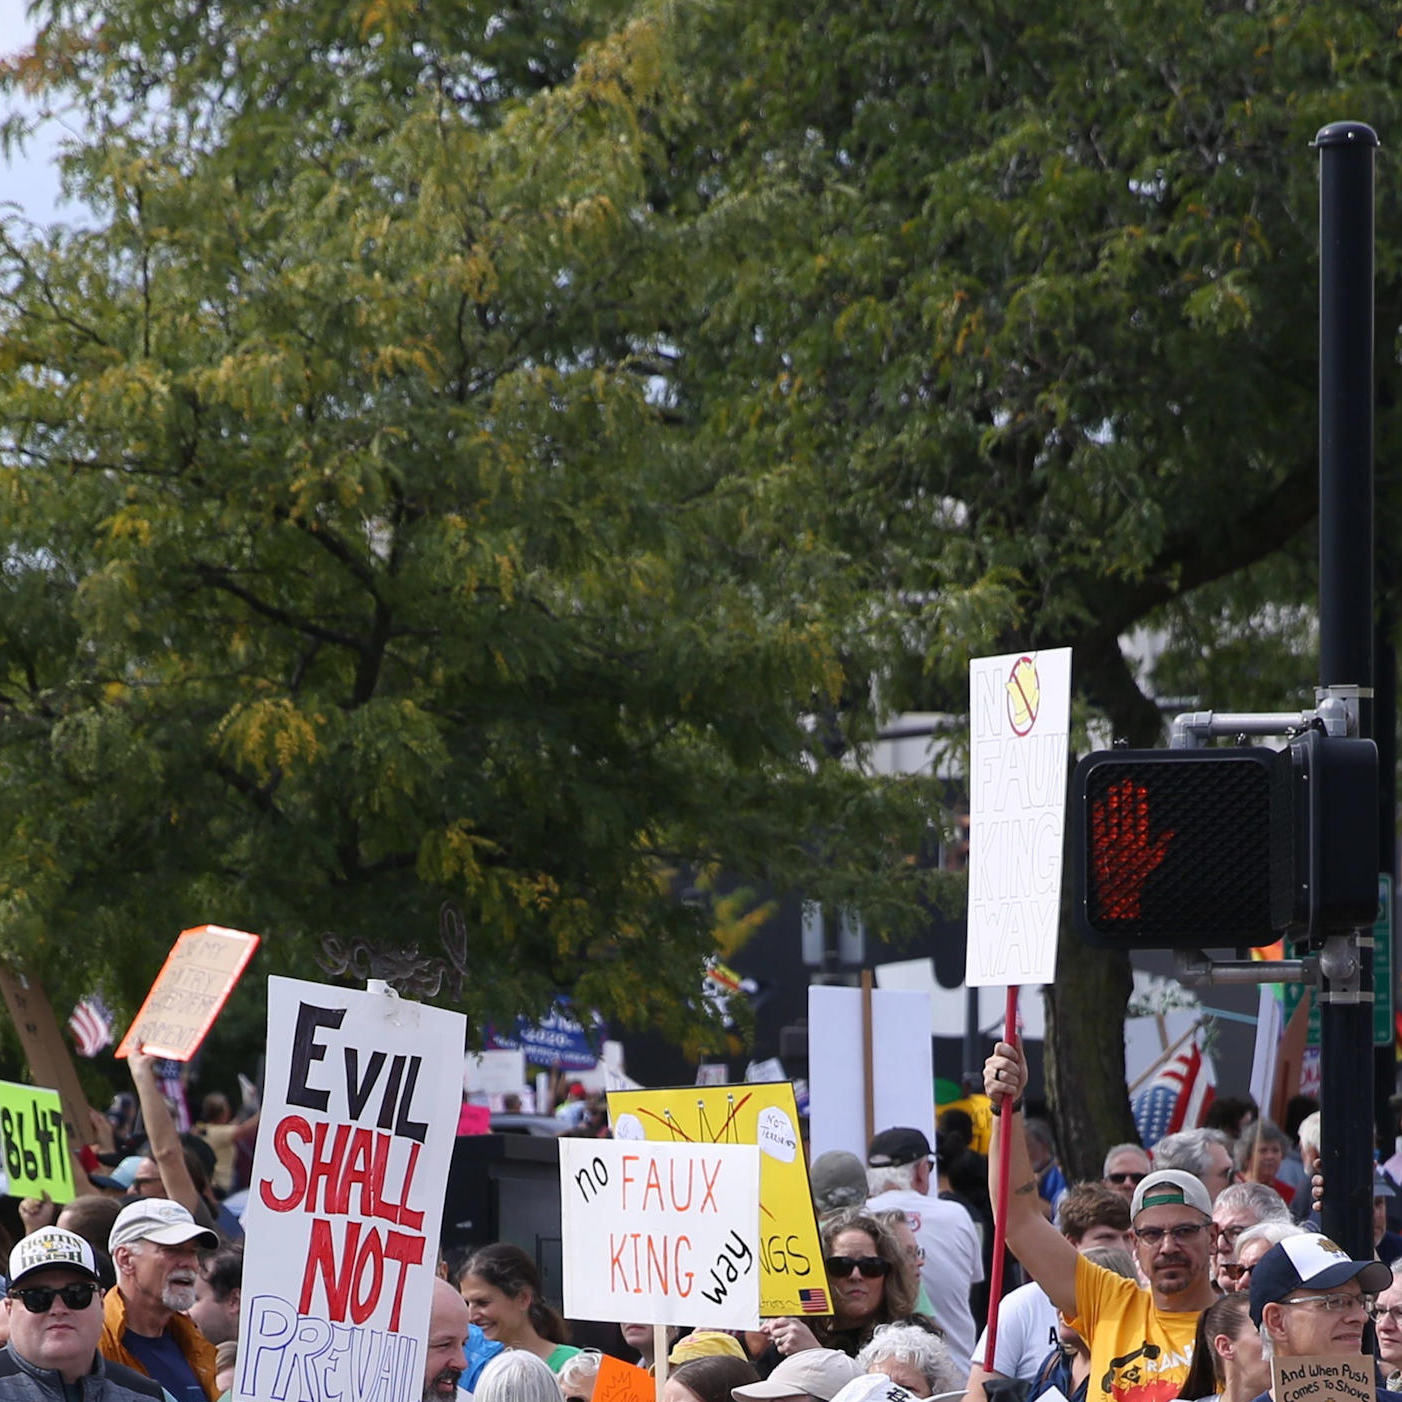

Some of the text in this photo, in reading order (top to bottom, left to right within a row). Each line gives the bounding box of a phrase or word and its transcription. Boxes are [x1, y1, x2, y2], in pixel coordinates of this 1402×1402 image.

[976, 733, 1068, 814] FAUX
[974, 812, 1061, 902] KING
[974, 900, 1058, 977] WAY
[259, 1115, 426, 1231] SHALL
[574, 1155, 722, 1214] no FAUX
[298, 1219, 426, 1333] NOT
[610, 1230, 753, 1305] KING way
[759, 1235, 812, 1277] NGS
[1281, 1364, 1369, 1385] And When Push
[1323, 1379, 1334, 1389] To
